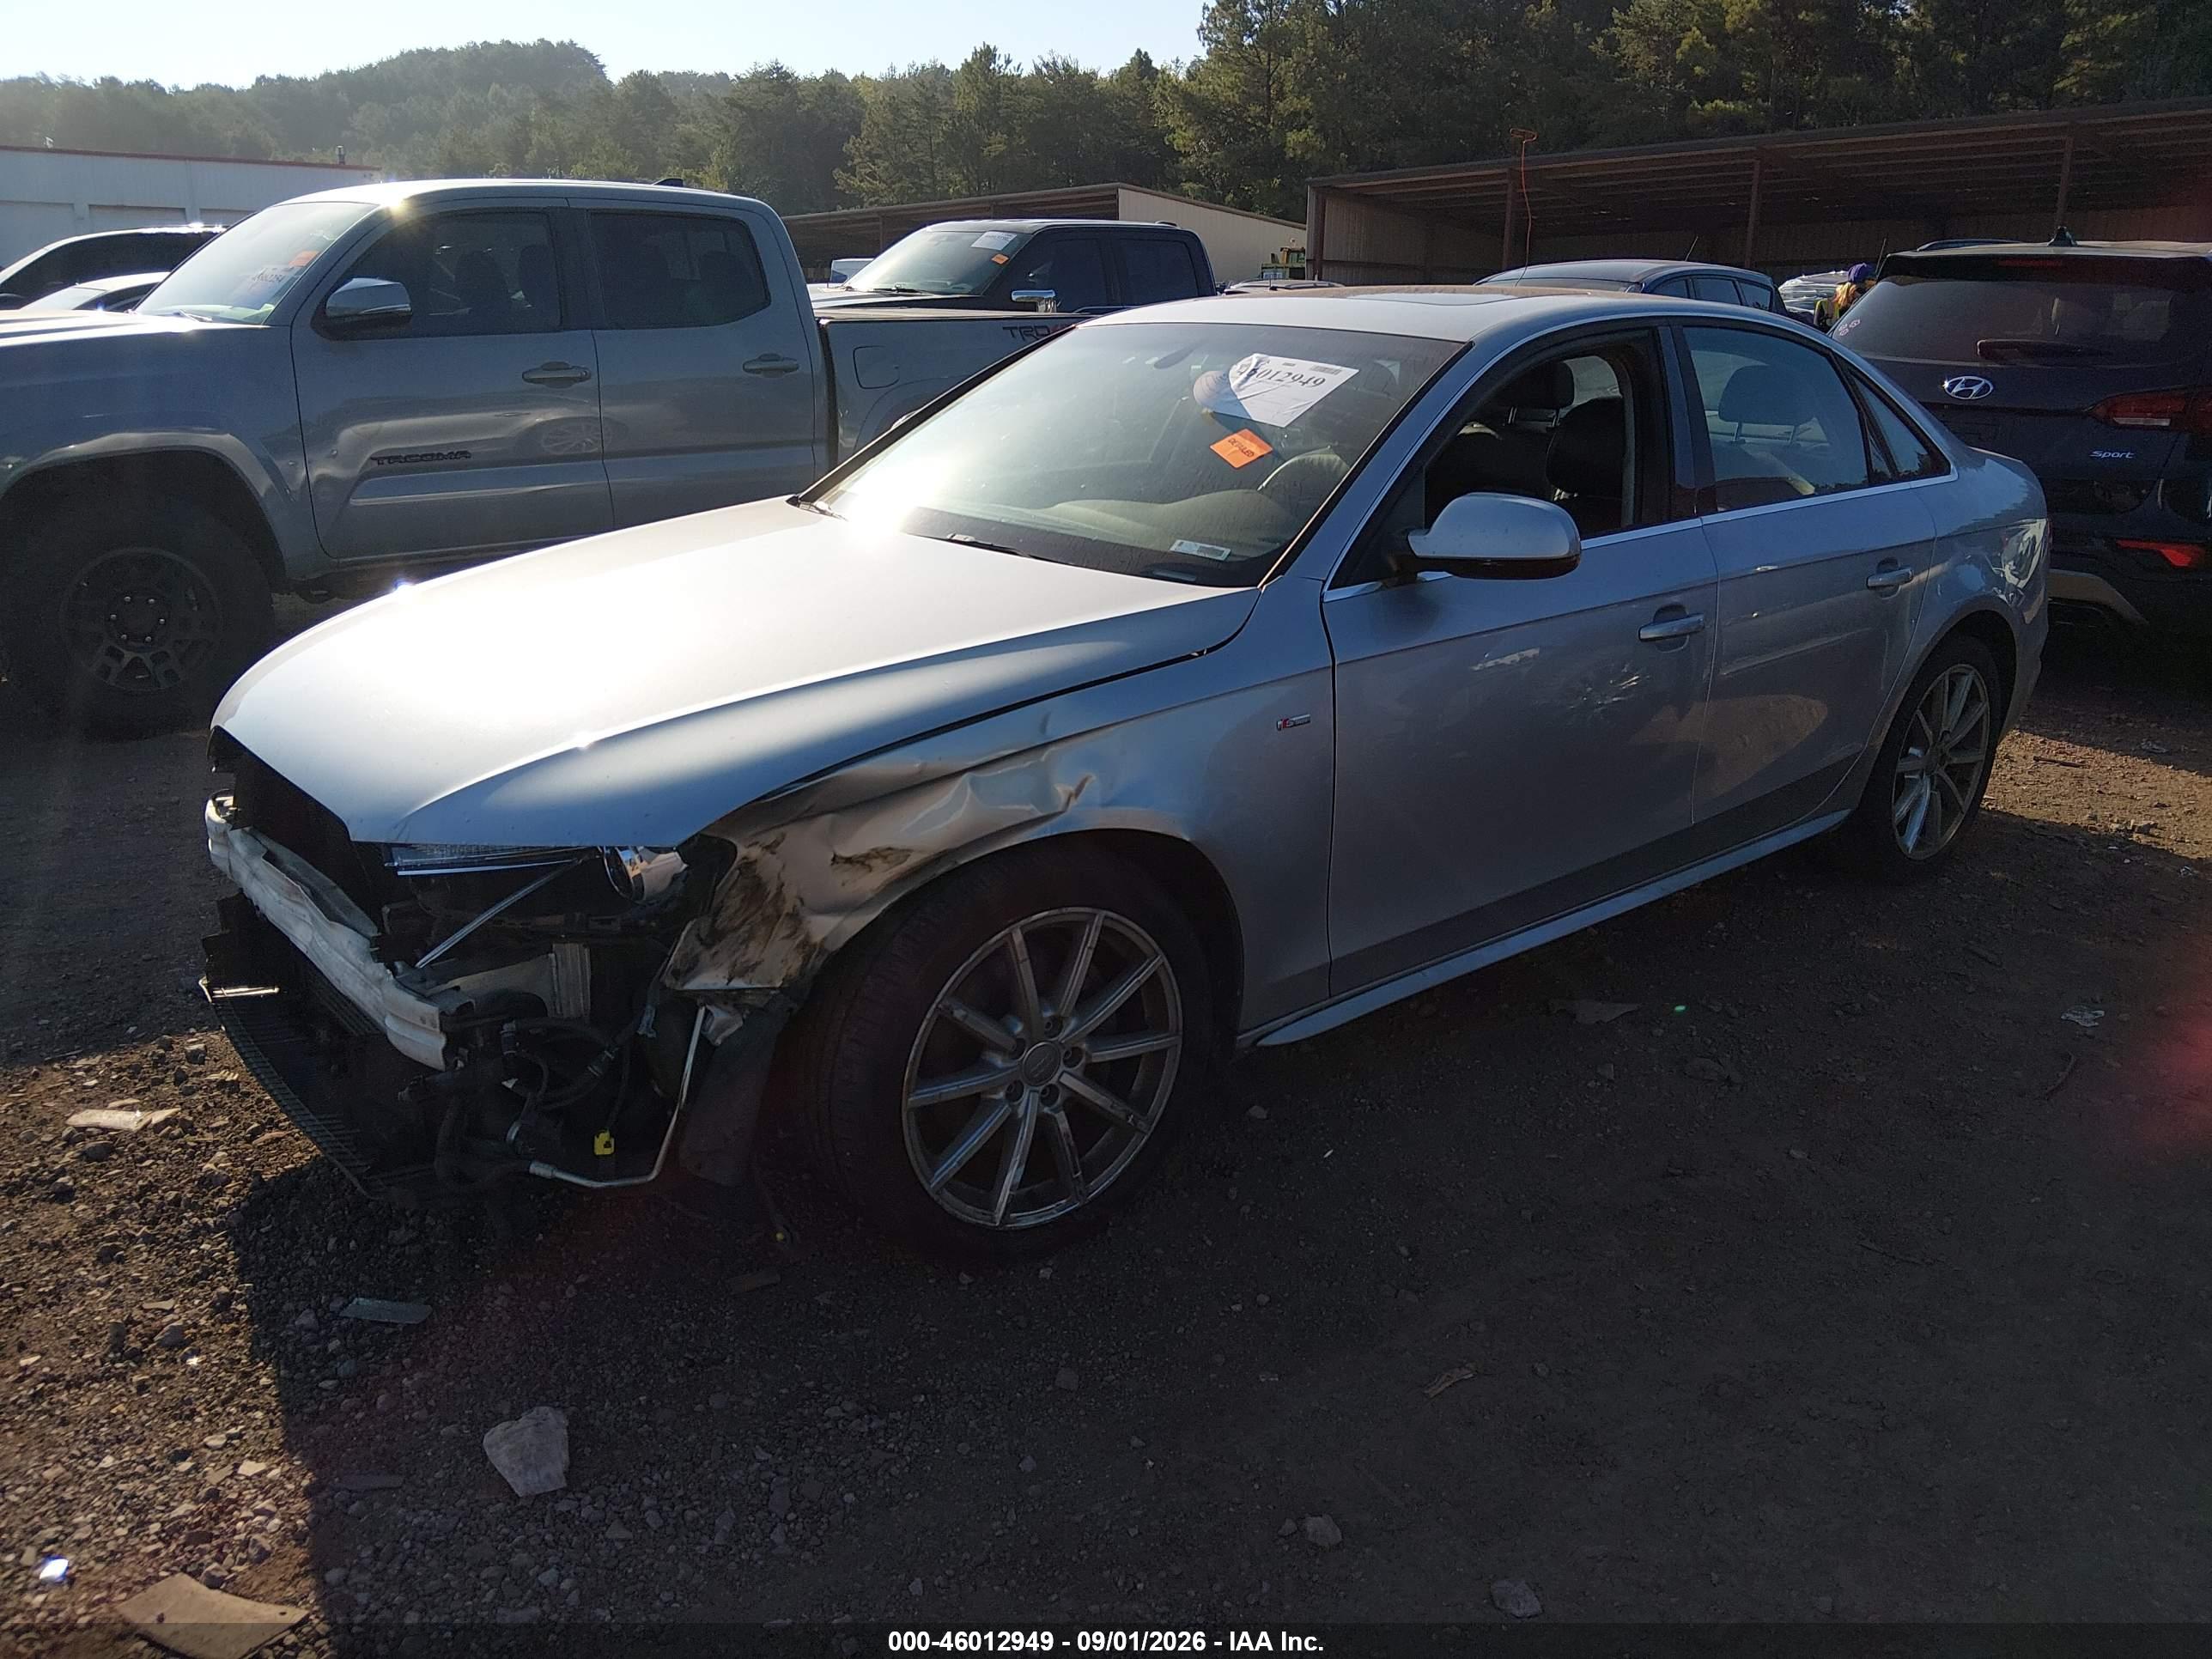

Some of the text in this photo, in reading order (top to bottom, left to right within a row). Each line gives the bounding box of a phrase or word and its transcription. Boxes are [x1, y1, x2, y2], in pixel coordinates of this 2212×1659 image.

[1002, 325, 1051, 341] TRD
[370, 451, 471, 465] TACOMA
[2088, 450, 2136, 459] Sport
